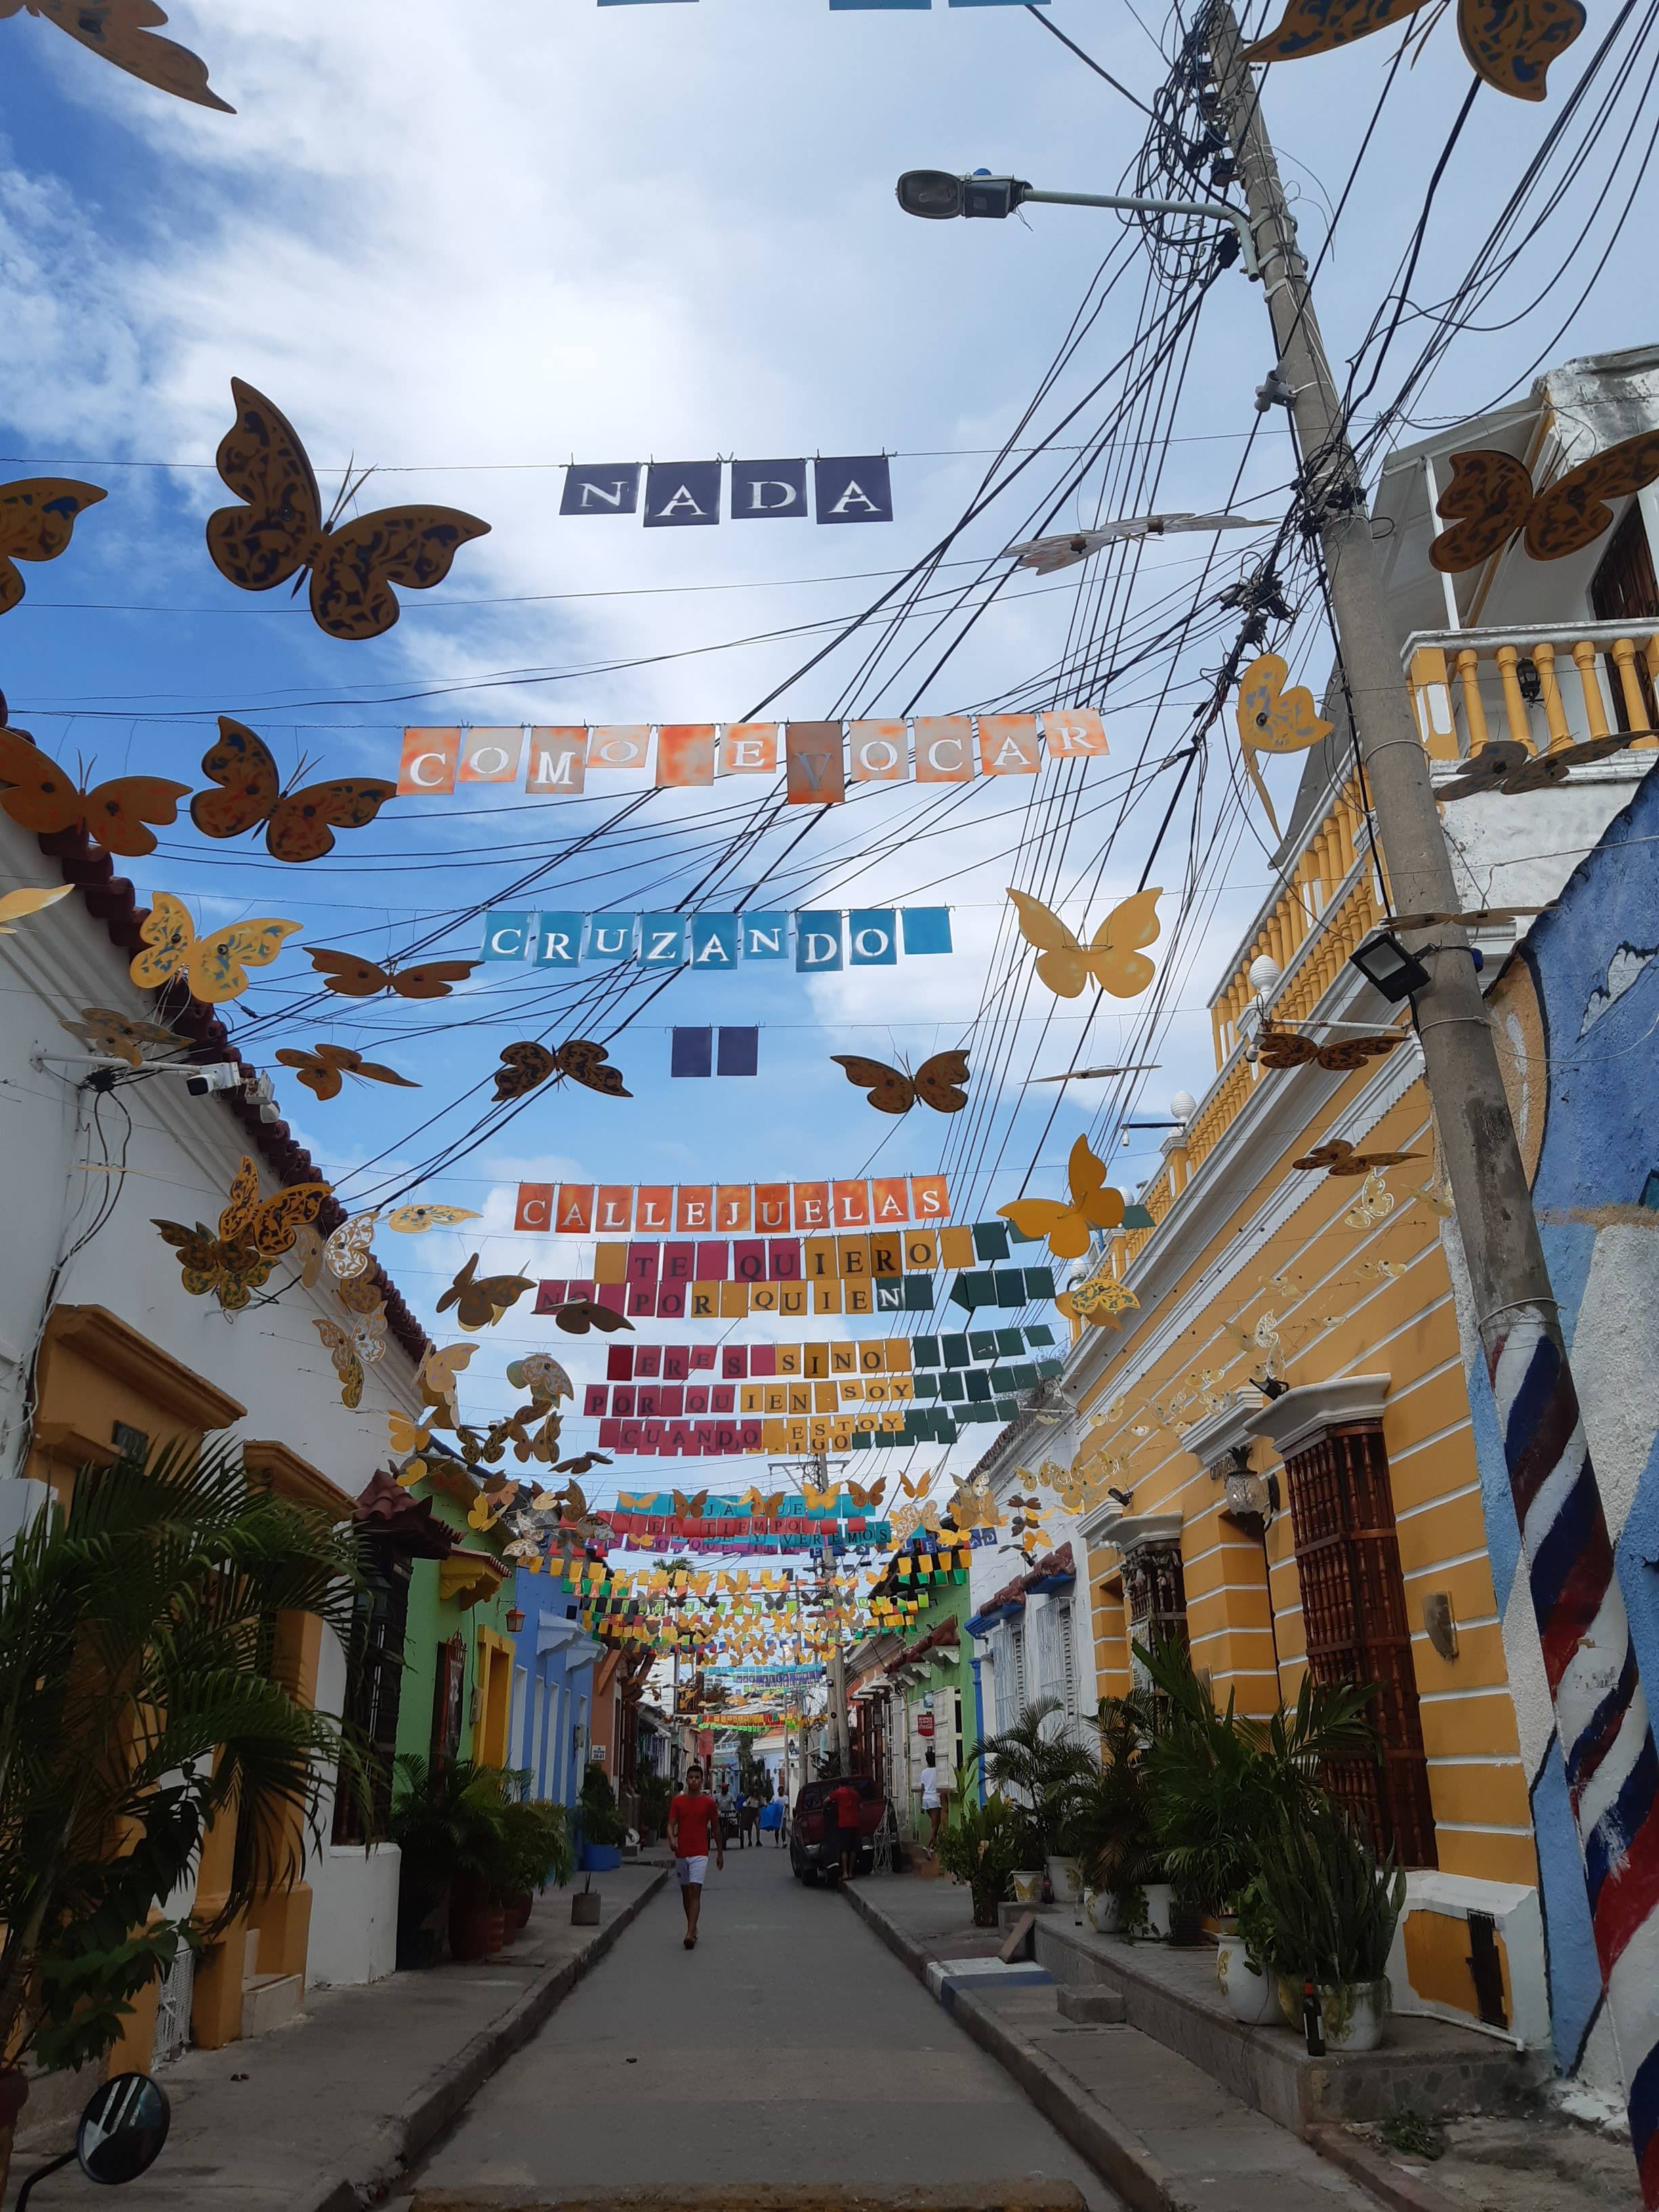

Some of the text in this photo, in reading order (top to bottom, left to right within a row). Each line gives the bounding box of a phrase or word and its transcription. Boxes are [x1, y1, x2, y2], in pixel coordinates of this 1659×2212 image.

[577, 480, 882, 517] NADA
[409, 726, 1106, 792] COMO EVOCAR
[491, 928, 888, 963] CRUZANDO
[523, 1190, 941, 1226] CALLEJUELAS
[635, 1243, 931, 1281] TE QUIERO
[635, 1293, 711, 1315] POR
[755, 1288, 901, 1311] QUIEN
[641, 1350, 881, 1376] ERES SINO
[591, 1384, 911, 1415] POR QUIEN SOY
[623, 1418, 899, 1447] CUANDO ESTOY
[653, 1520, 799, 1534] EL TIEMPO
[783, 1528, 888, 1544] VEREMOS
